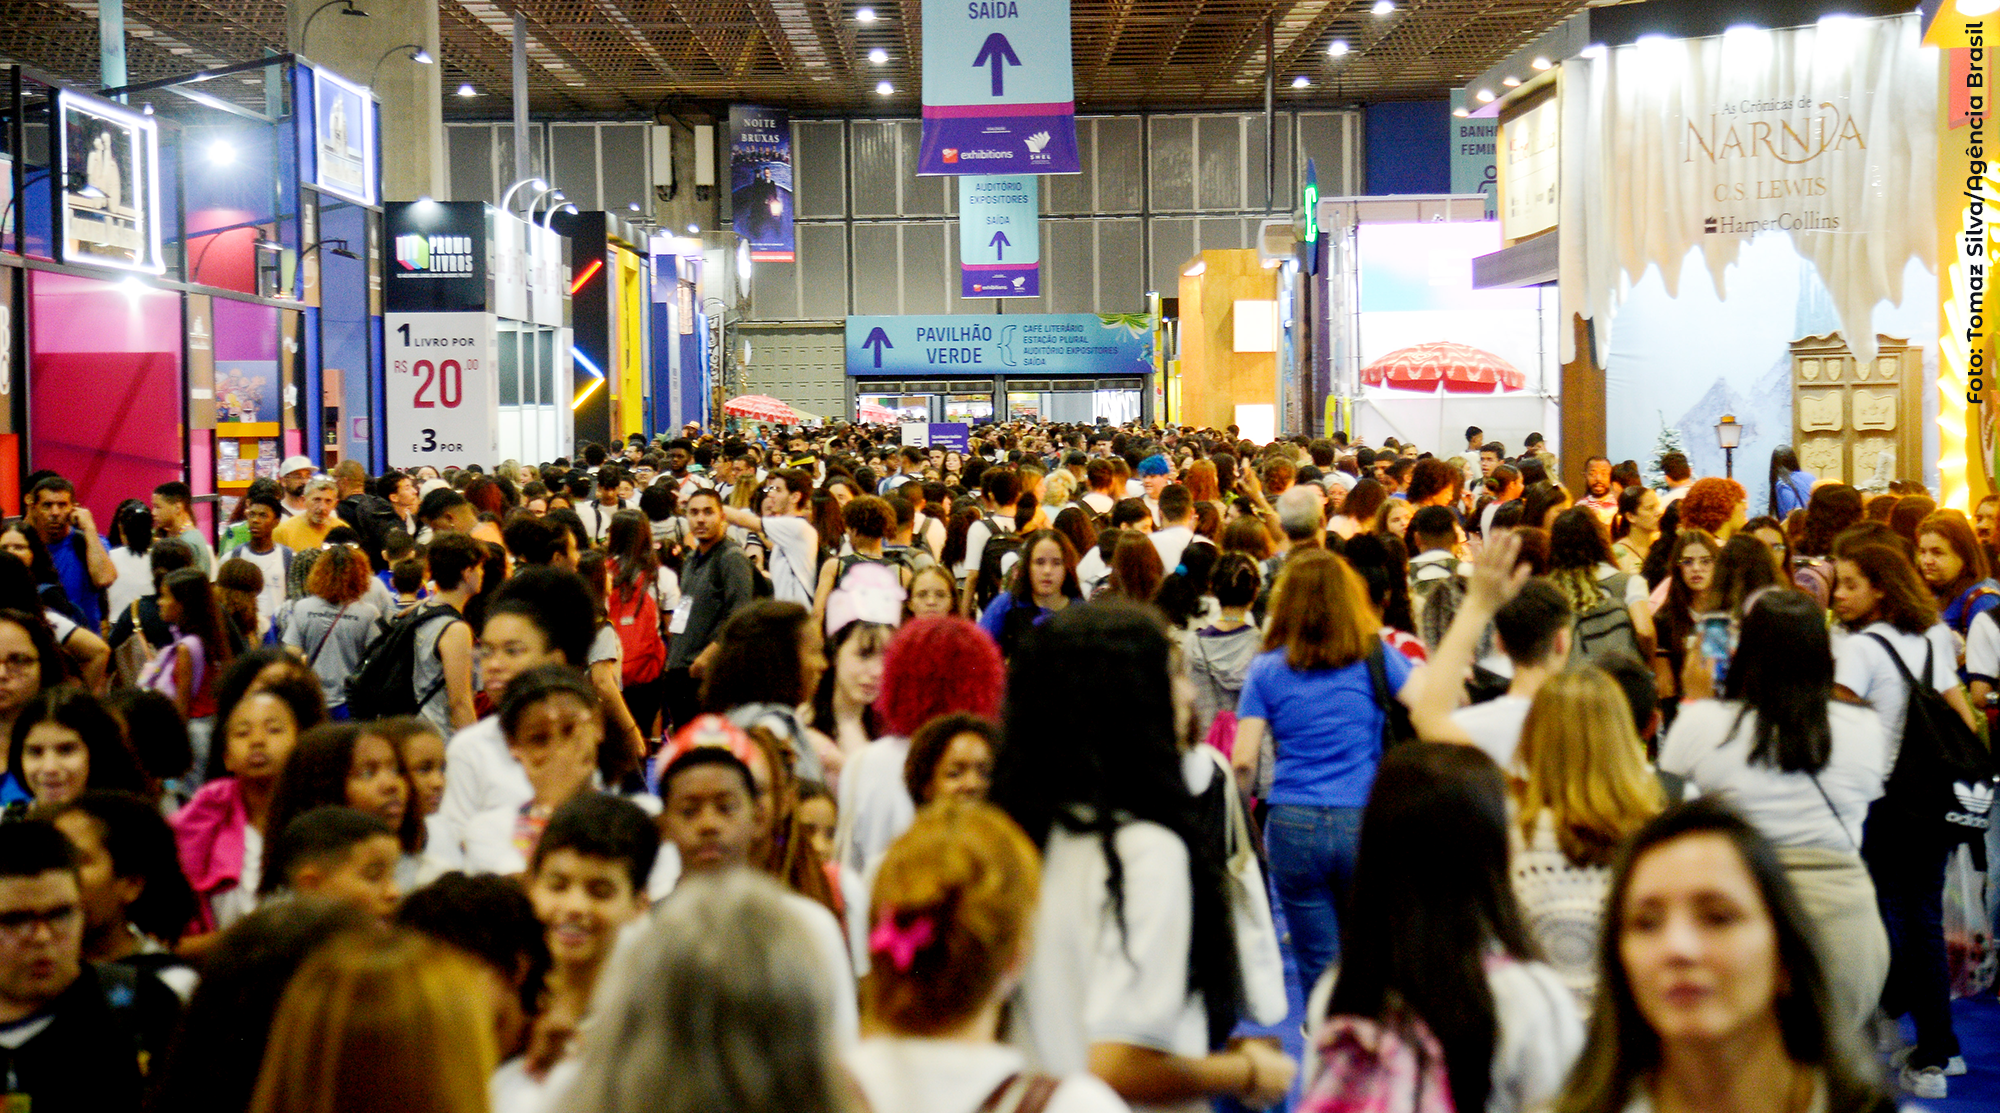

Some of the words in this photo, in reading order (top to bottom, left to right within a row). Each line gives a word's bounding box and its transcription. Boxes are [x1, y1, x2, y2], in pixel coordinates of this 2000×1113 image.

[968, 0, 1018, 20] SAÍDA
[1722, 102, 1736, 115] As
[1740, 98, 1794, 114] Crônicas
[1797, 95, 1812, 109] de
[743, 118, 776, 128] NOITE
[741, 134, 780, 143] BRUXAS
[960, 149, 1014, 160] exhibitions
[976, 181, 1022, 192] AUDITÓRIO
[1714, 182, 1749, 202] C.S.
[1756, 177, 1827, 200] LEWIS
[970, 194, 1028, 204] EXPOSITORES
[1720, 211, 1840, 237] HarperCollins
[428, 236, 472, 254] PROMO
[429, 254, 474, 272] LIVROS
[397, 323, 410, 347] 1
[414, 338, 448, 347] LIVRO
[452, 338, 475, 346] POR
[916, 324, 992, 342] PAVILHÃO
[1044, 322, 1084, 332] LITERÁRIO
[1060, 336, 1088, 344] PLURAL
[926, 348, 982, 364] VERDE
[1024, 346, 1064, 354] AUDITÓRIO
[1066, 346, 1119, 354] EXPOSITORES
[1024, 356, 1046, 366] SAÍDA
[412, 359, 462, 408] 20
[412, 444, 418, 452] E
[421, 428, 437, 452] 3
[440, 444, 464, 452] POR
